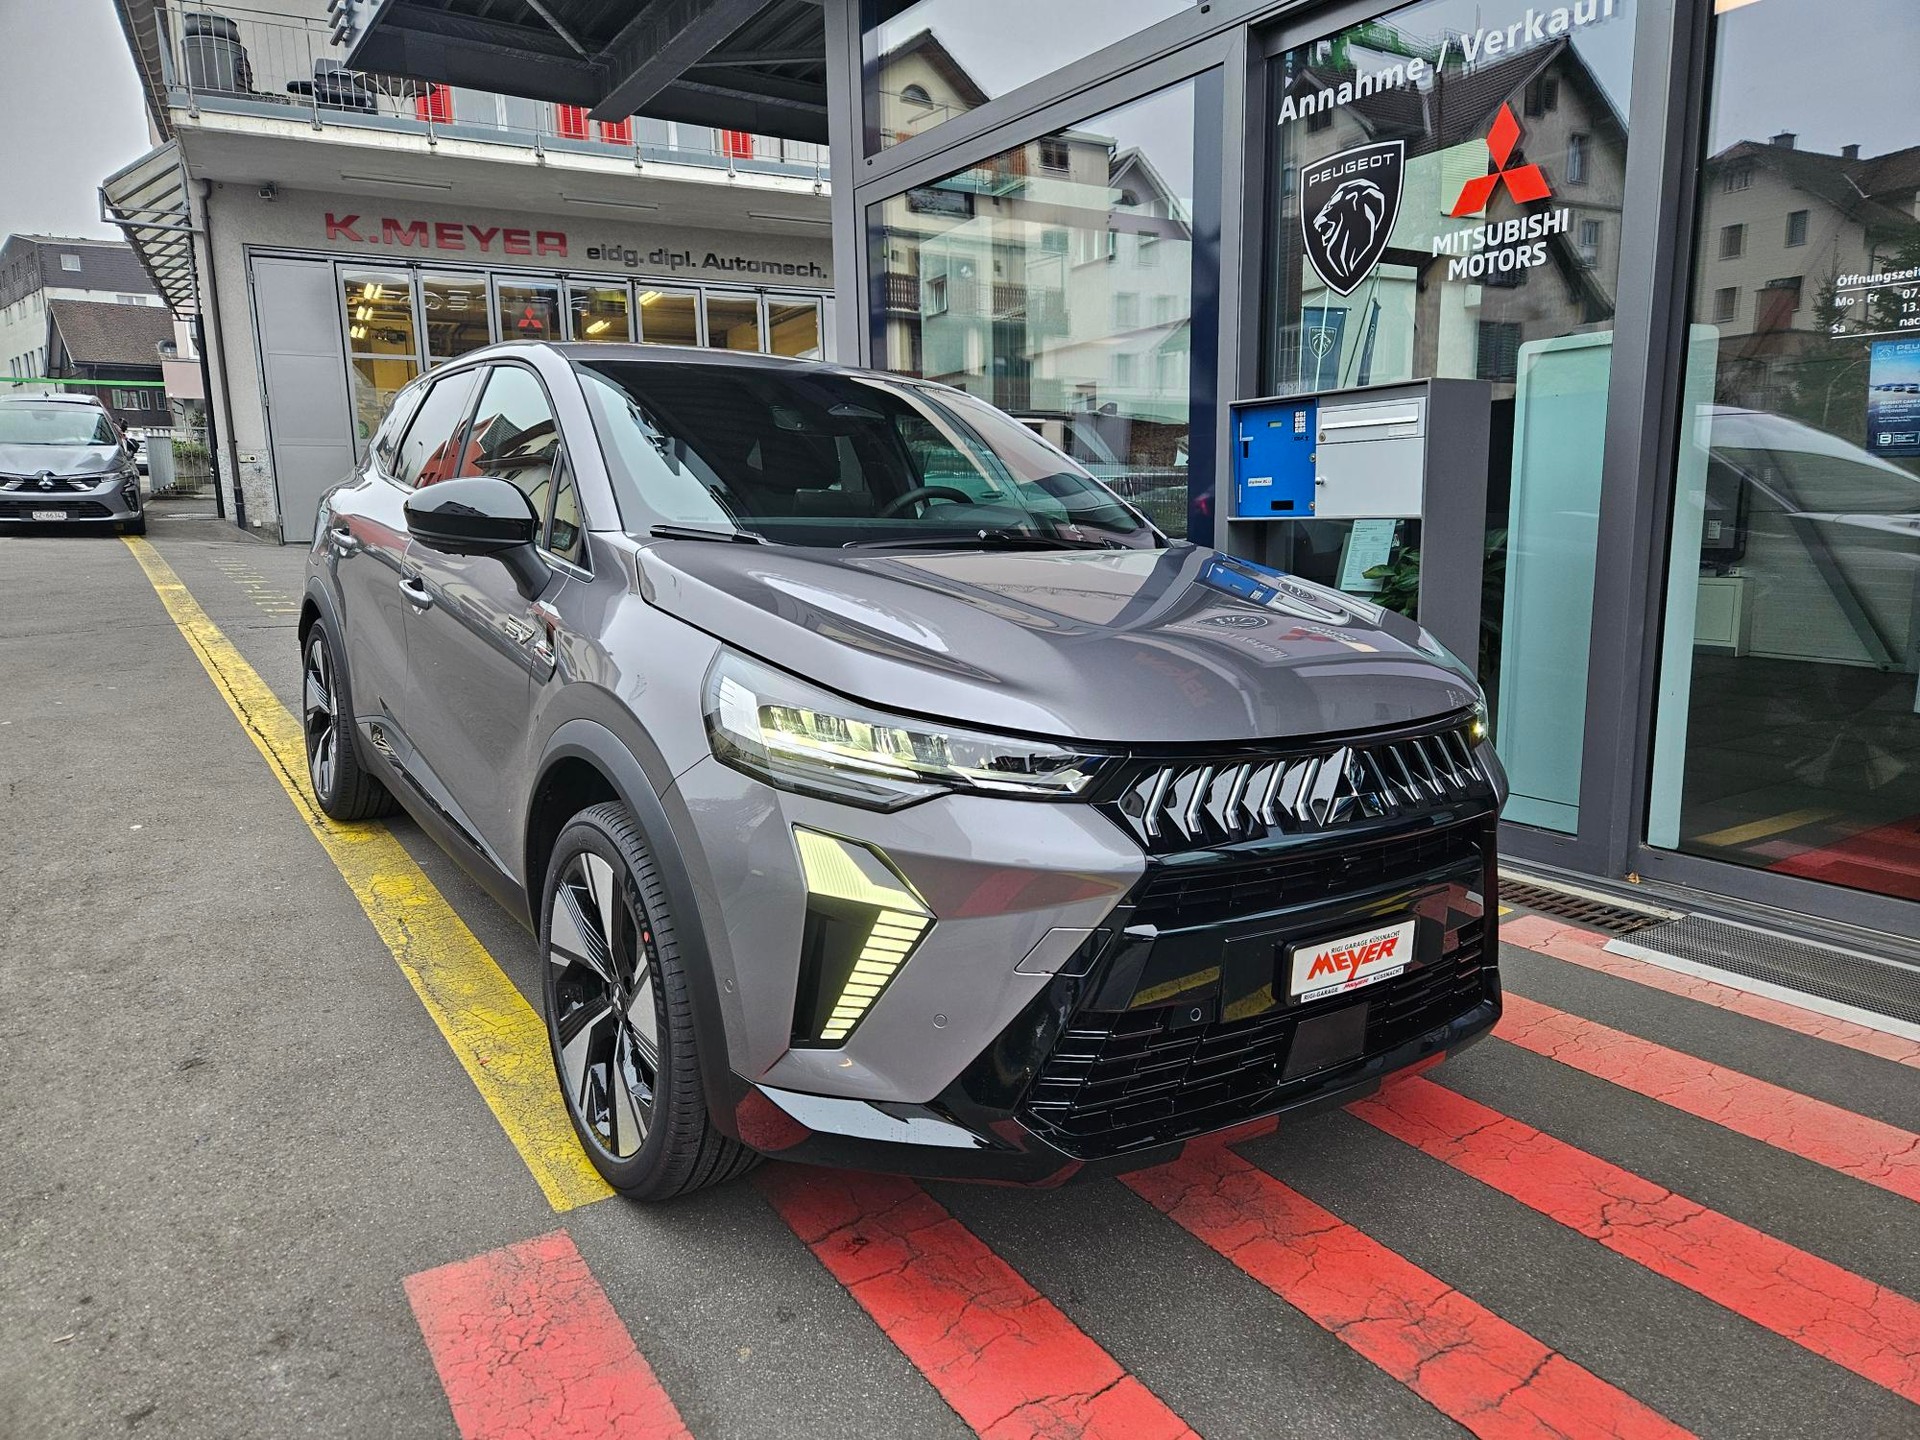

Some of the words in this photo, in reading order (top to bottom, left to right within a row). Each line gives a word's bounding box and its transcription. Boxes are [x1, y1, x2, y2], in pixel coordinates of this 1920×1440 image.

[1277, 57, 1424, 126] Annahme
[1435, 40, 1449, 73] /
[1308, 152, 1395, 187] PEUGEOT
[324, 212, 568, 258] K.MEYER
[1432, 208, 1569, 258] MITSUBISHI
[586, 242, 645, 269] eidg.
[649, 246, 697, 274] dipl.
[701, 254, 828, 279] Automech.
[1447, 242, 1547, 281] MOTORS
[1835, 296, 1855, 307] Mo
[1867, 293, 1880, 303] Fr
[1832, 323, 1846, 334] Sa
[634, 902, 667, 1019] MIHELIN
[1306, 937, 1399, 981] MEYER
[1344, 938, 1368, 950] GARAGE
